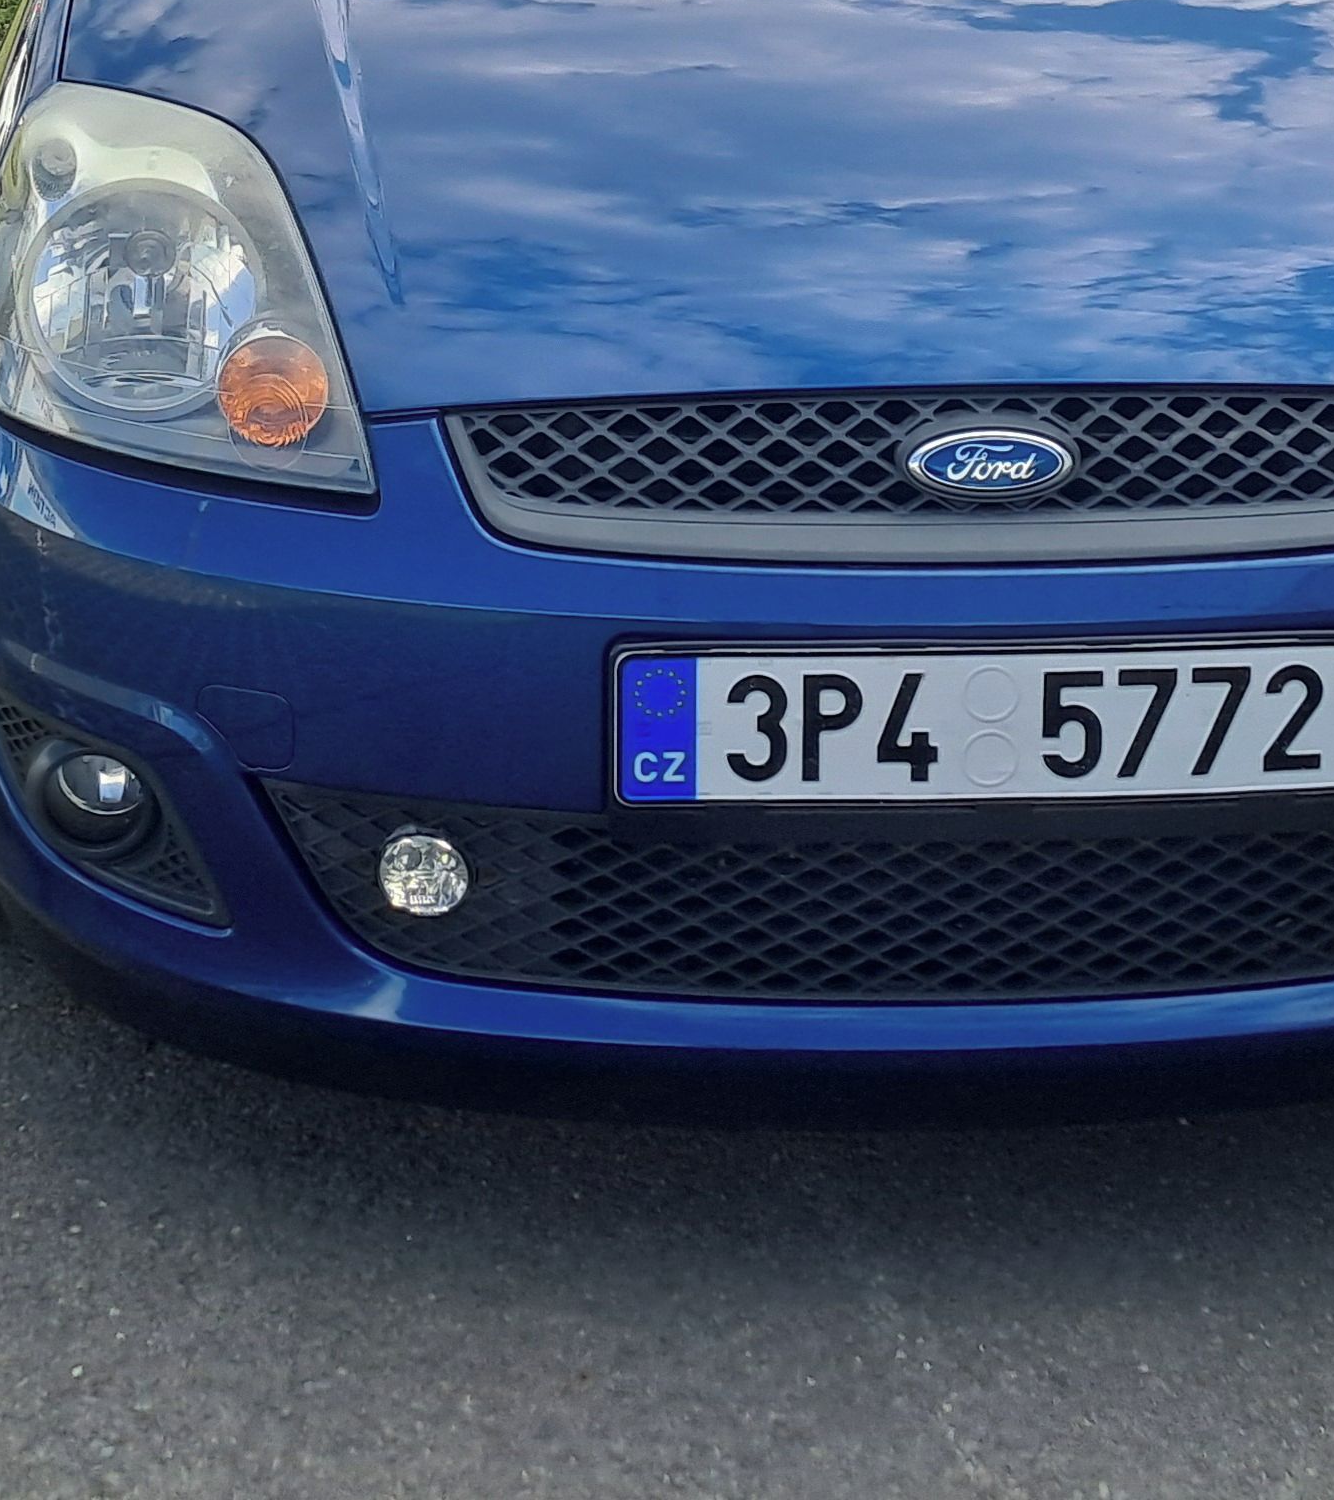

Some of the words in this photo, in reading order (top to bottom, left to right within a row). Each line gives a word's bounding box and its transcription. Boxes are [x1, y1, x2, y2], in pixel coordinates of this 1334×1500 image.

[947, 443, 1036, 481] Ford
[726, 673, 939, 782] 3P4
[1041, 665, 1325, 779] 5772
[634, 751, 686, 783] CZ
